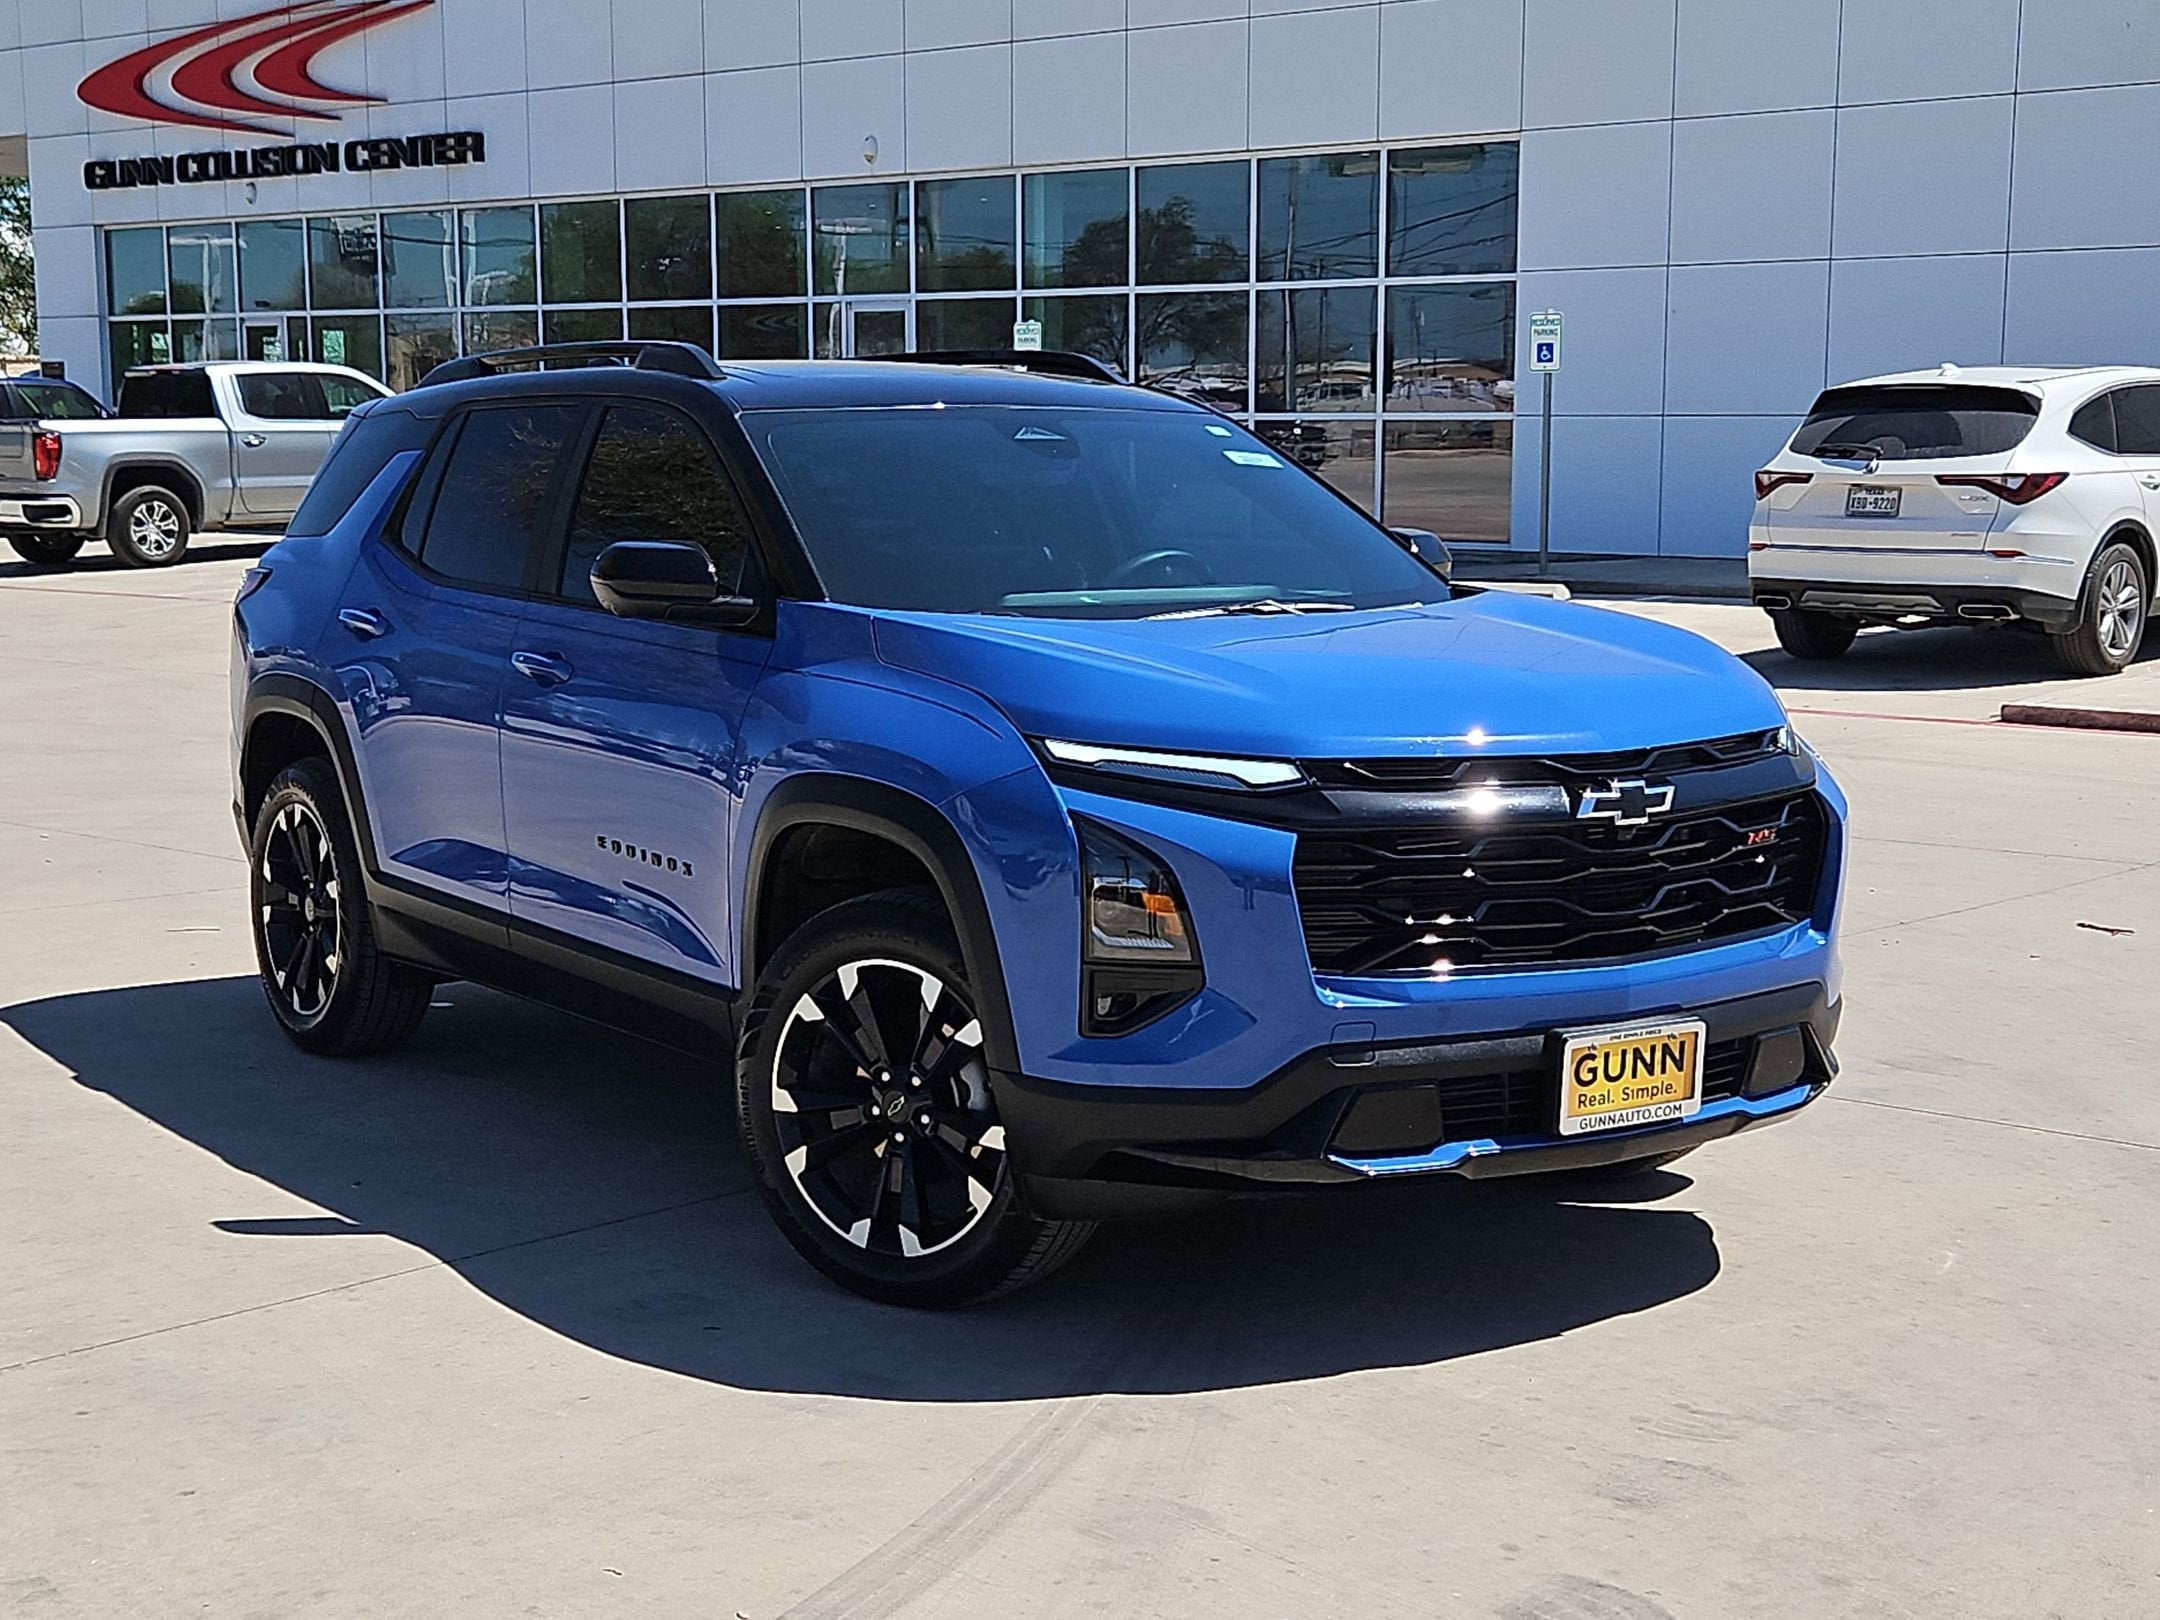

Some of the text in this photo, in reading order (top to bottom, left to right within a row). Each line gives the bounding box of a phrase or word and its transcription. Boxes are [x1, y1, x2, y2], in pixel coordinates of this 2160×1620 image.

[84, 131, 486, 190] GUNN COLLISION CENTER
[596, 835, 694, 877] EQUINOX
[1573, 1040, 1686, 1088] GUNN
[1577, 1080, 1678, 1109] Real. Simple.
[1579, 1103, 1683, 1130] GUNNAUTO.COM
